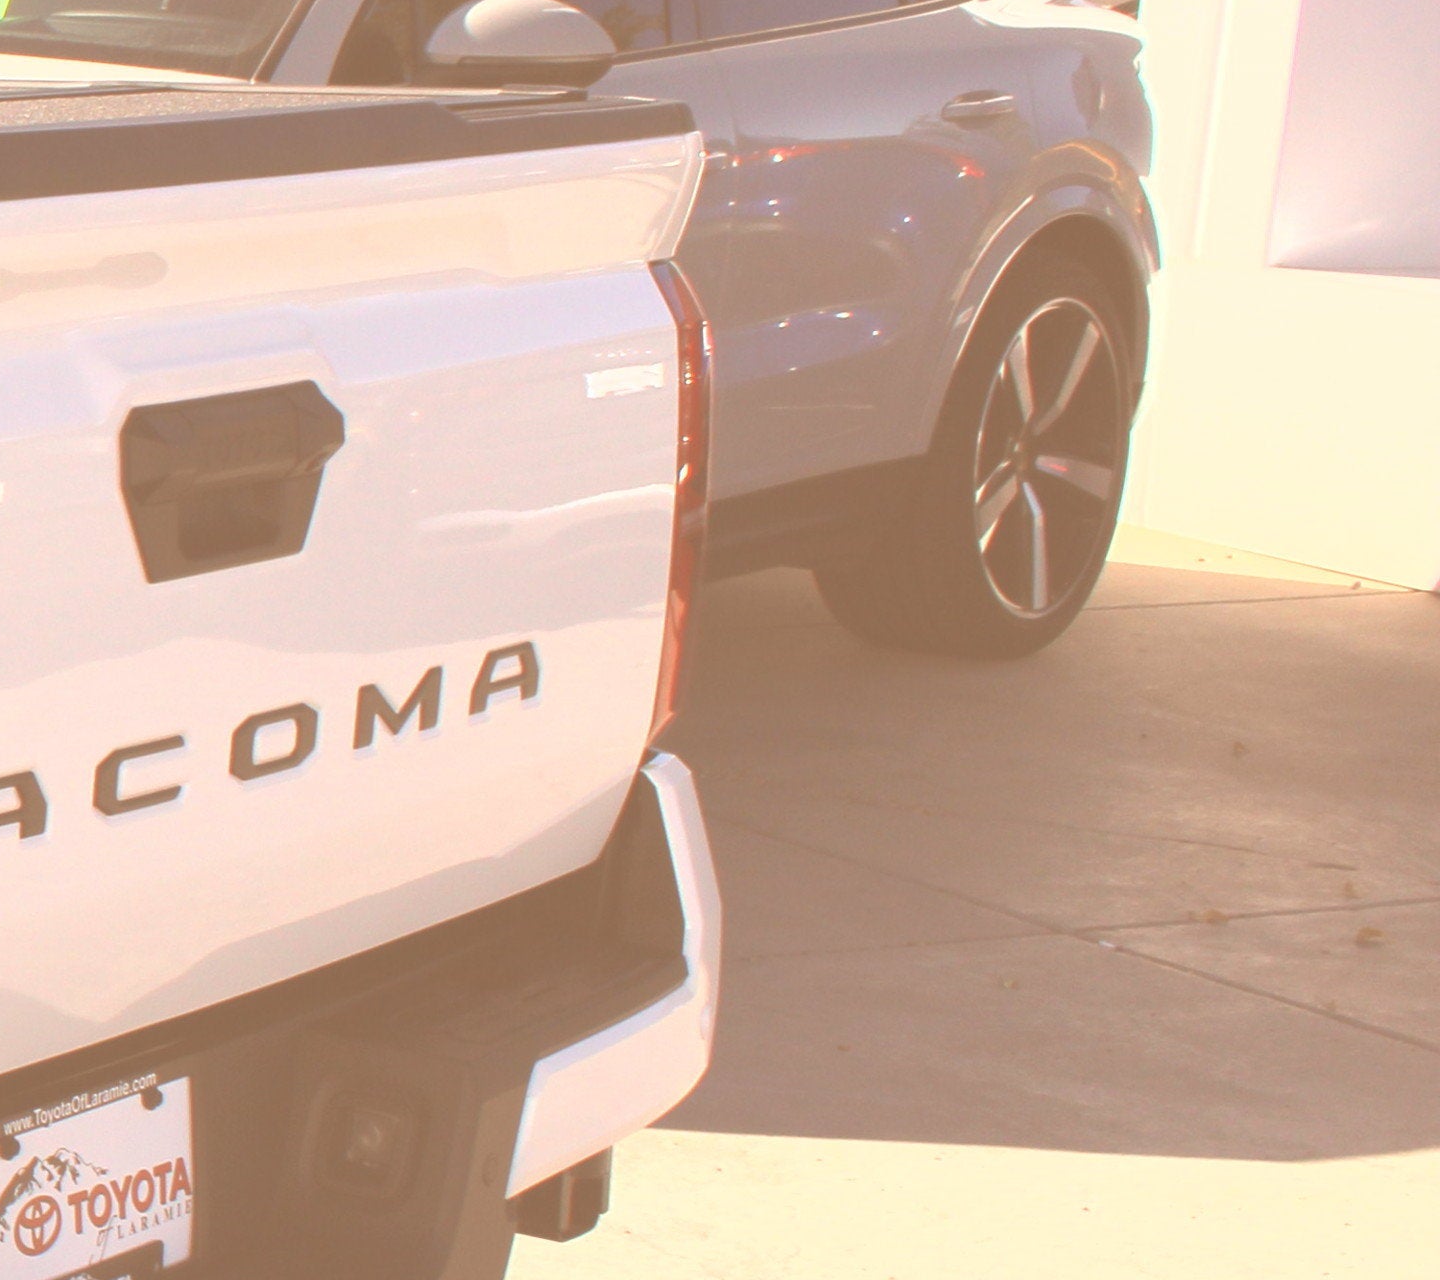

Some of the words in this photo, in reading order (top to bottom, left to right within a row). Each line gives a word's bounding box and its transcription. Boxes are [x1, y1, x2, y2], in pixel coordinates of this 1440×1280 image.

[2, 1072, 158, 1137] www.ToyotaOfLaramie.com
[67, 1156, 193, 1235] TOYOTA
[116, 1199, 192, 1240] LARAMIE
